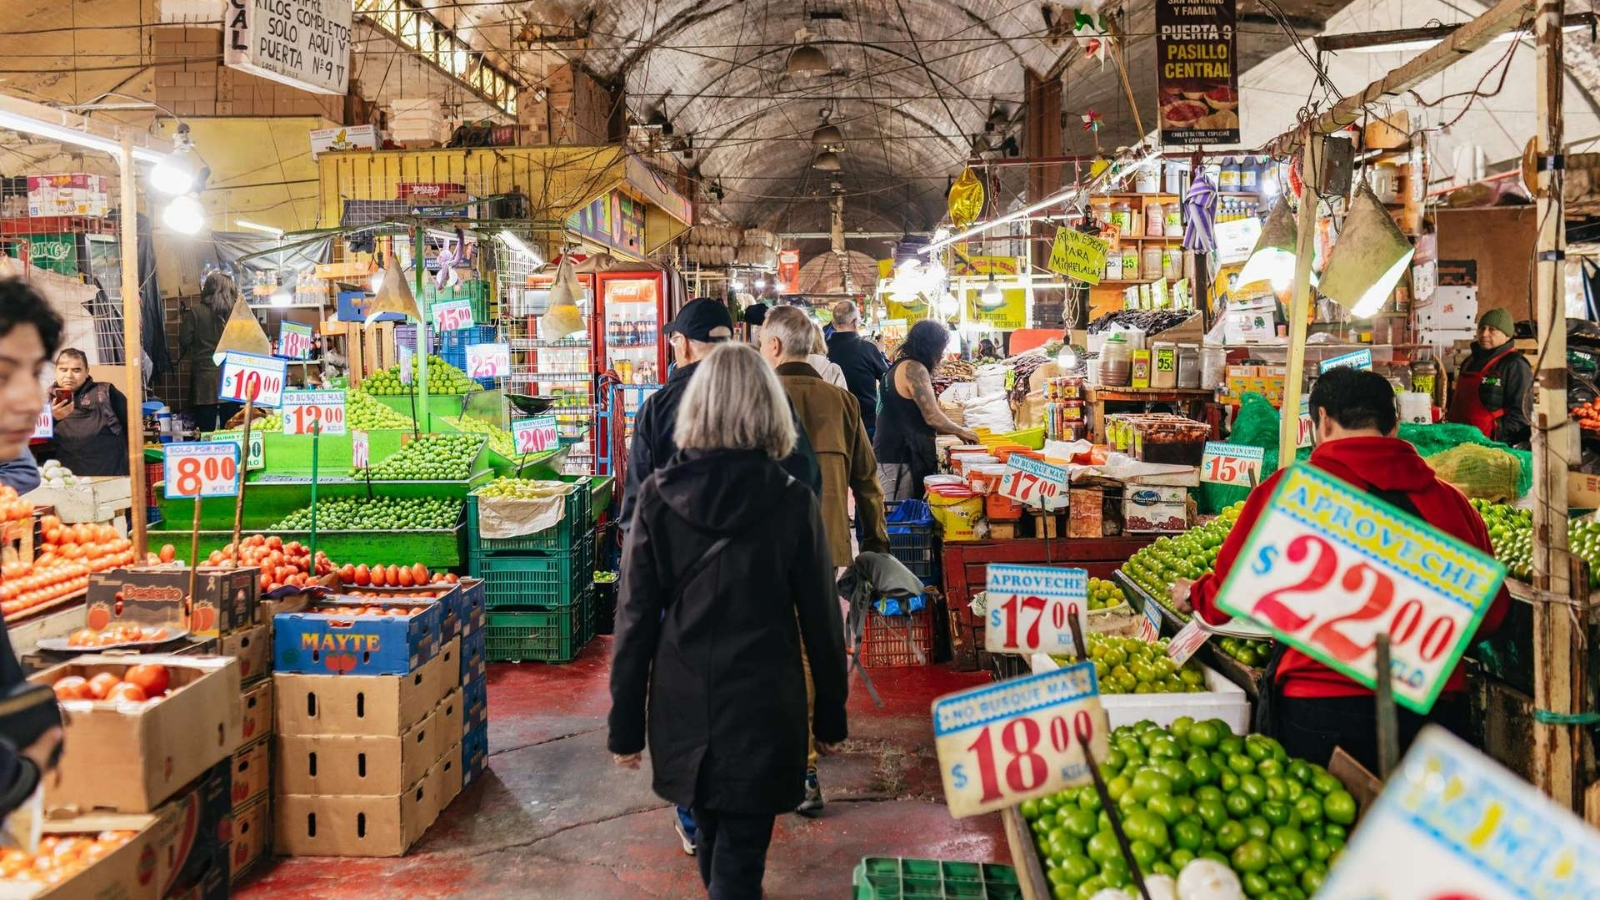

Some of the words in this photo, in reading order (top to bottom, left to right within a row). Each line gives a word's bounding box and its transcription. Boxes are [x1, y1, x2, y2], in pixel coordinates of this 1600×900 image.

[1174, 7, 1179, 15] Y
[1182, 6, 1217, 15] FAMILIA
[268, 17, 298, 42] SOLO
[296, 9, 352, 43] COMPLETOS
[1161, 25, 1219, 40] PUERTA
[1222, 25, 1232, 40] 9
[260, 37, 302, 70] PUERTA
[1167, 44, 1228, 59] PASILLO
[1165, 62, 1232, 78] CENTRAL
[234, 369, 261, 402] 10
[292, 405, 323, 435] 12
[520, 429, 546, 453] 20
[1209, 455, 1237, 482] 15
[1008, 471, 1040, 500] 17
[1289, 485, 1487, 592] APROVECHE
[1251, 544, 1280, 577] $
[123, 585, 183, 601] Desierto
[991, 574, 1082, 590] APROVECHE
[1252, 534, 1396, 663] 22
[991, 609, 1002, 627] $
[1001, 594, 1047, 650] 17
[302, 633, 380, 651] MAYTE
[953, 706, 975, 719] NO
[980, 688, 1041, 714] BUSQUE
[1047, 678, 1080, 694] MAS
[951, 763, 968, 789] $
[966, 717, 1049, 804] 18
